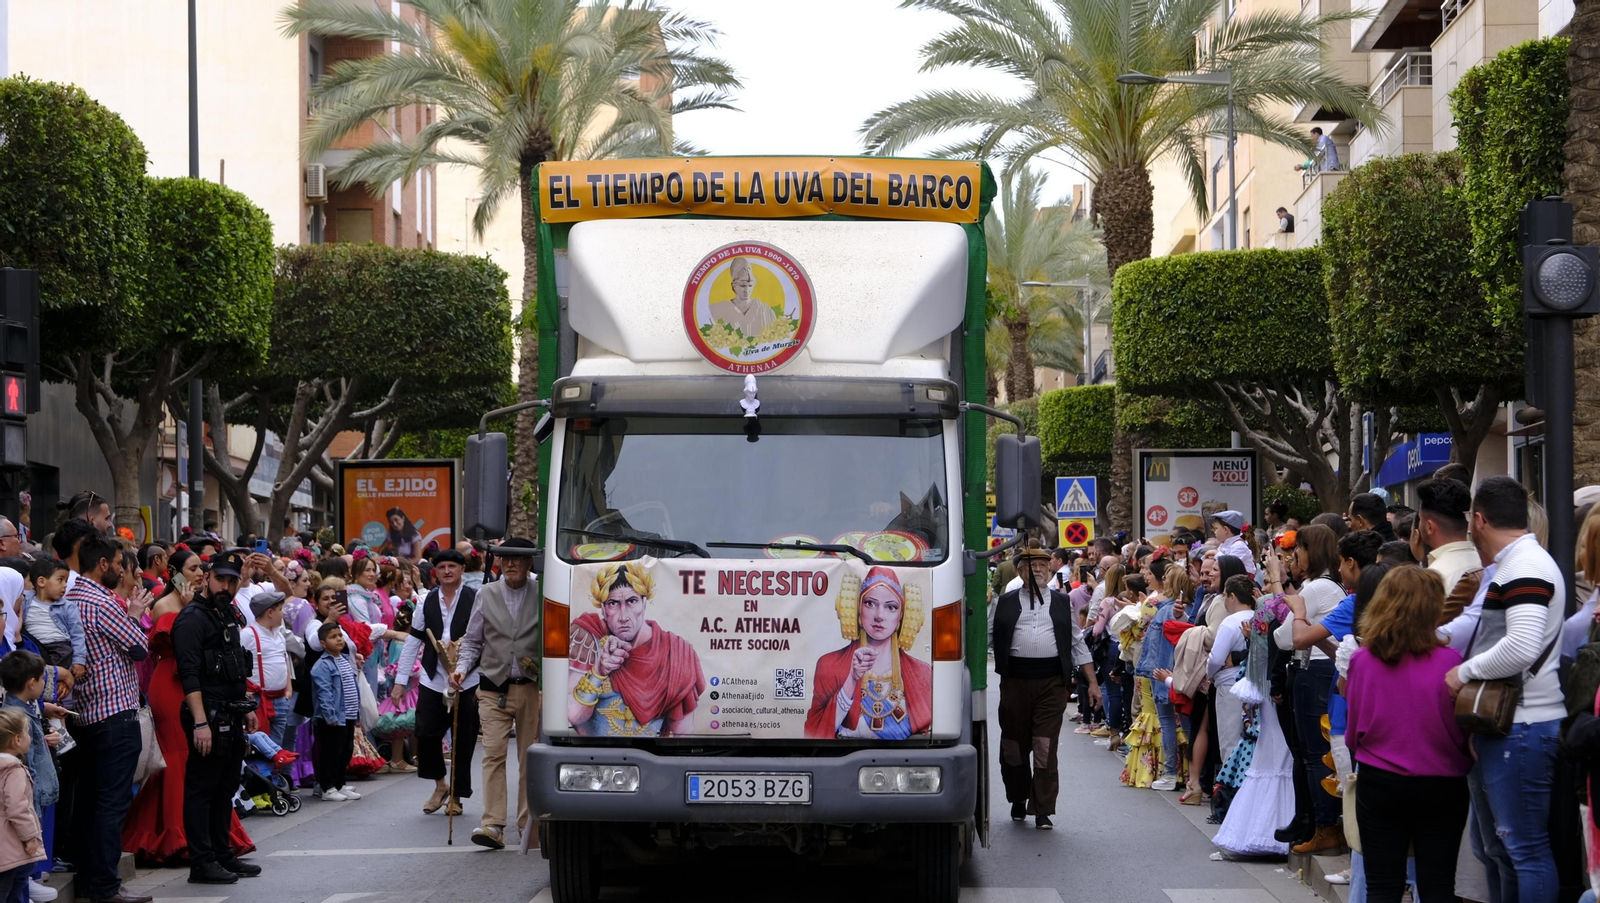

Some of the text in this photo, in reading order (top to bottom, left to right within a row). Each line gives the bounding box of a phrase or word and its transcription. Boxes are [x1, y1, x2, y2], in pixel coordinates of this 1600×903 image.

[549, 171, 972, 210] EL TIEMPO DE LA UVA DEL BARCO
[691, 256, 717, 285] TIEMPO
[718, 250, 730, 259] DE
[745, 246, 762, 254] UVA
[764, 250, 782, 263] 1900
[743, 347, 760, 356] Uva
[761, 345, 770, 353] de
[728, 360, 777, 373] ATHENAA
[1213, 458, 1248, 470] MENÚ
[1213, 471, 1248, 482] 4YOU
[356, 477, 437, 492] EL EJIDO
[678, 570, 829, 596] TE NECESITO
[744, 600, 758, 612] EN
[700, 617, 801, 633] A.C. ATHENAA
[710, 639, 790, 651] HAZTE SOCIO/A
[721, 677, 758, 686] ACAthenaa
[721, 692, 765, 701] AthenaaEjido
[721, 706, 805, 715] asociacion_cultural_athenaa
[721, 720, 781, 729] athenaa.es/socios
[703, 779, 756, 798] 2053
[764, 779, 804, 798] BZG
